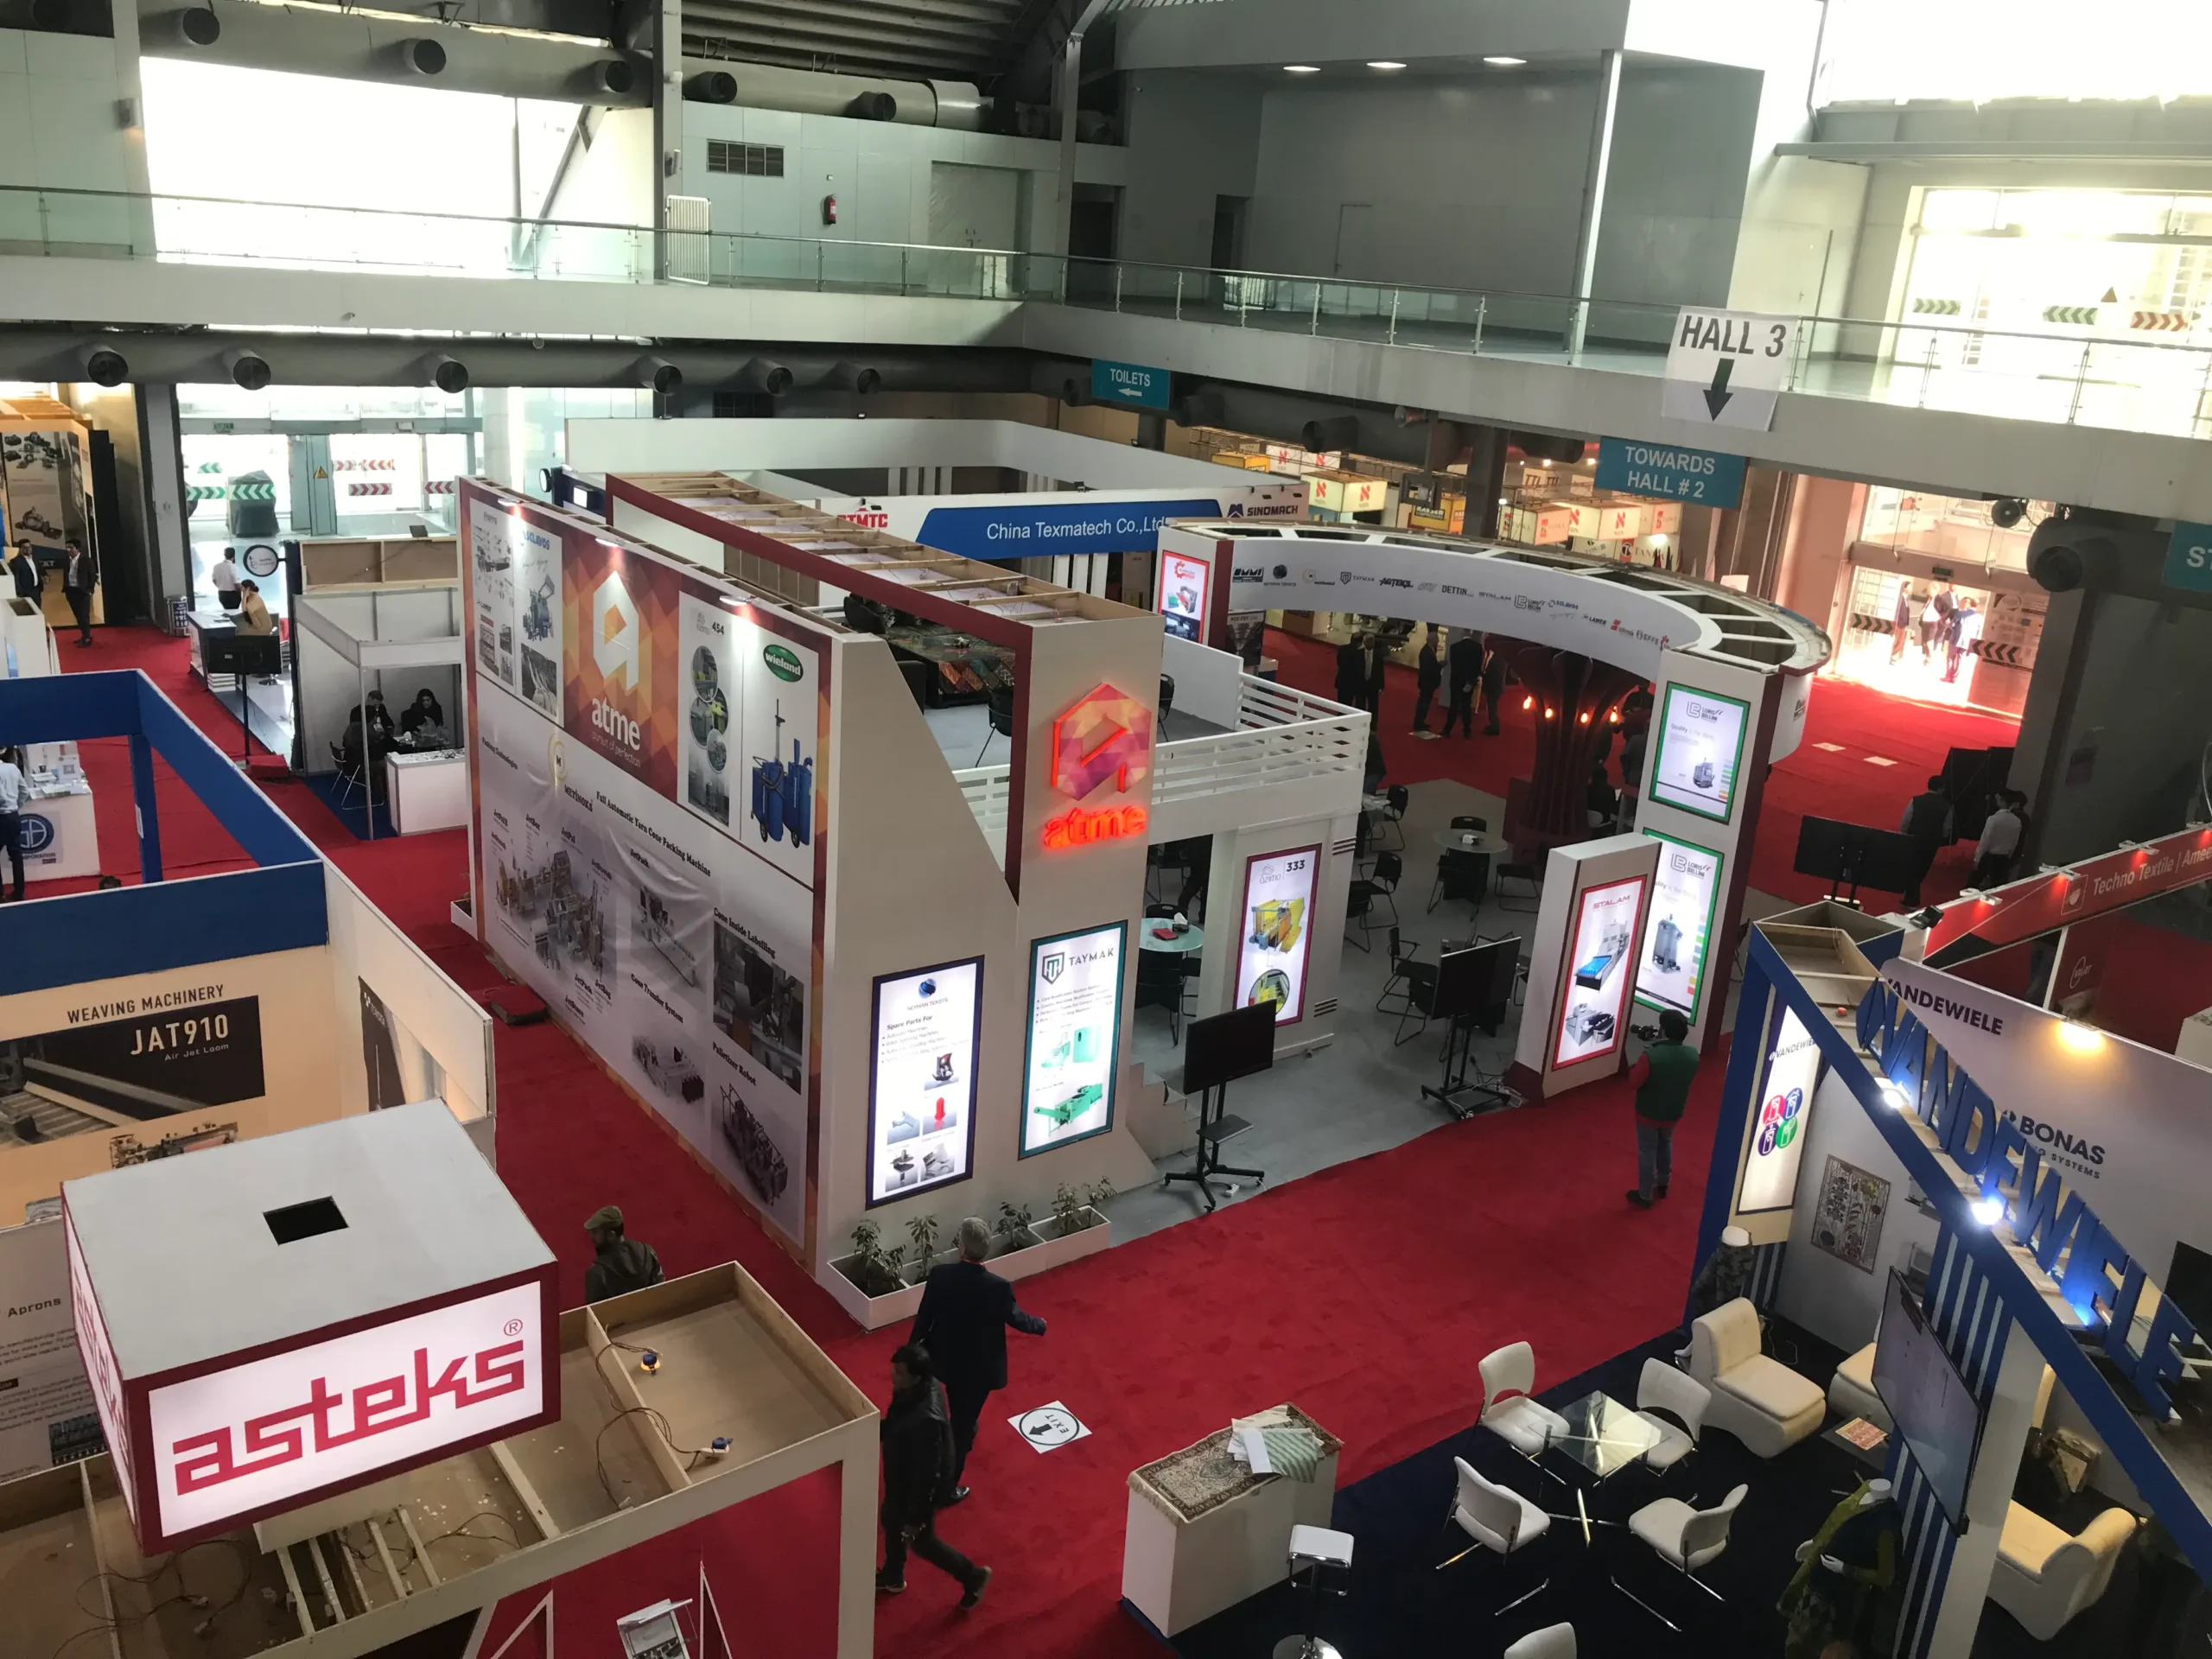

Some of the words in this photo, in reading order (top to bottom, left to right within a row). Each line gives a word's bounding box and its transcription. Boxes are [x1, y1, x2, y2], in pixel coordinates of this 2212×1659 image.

[1680, 315, 1754, 354] HALL
[1764, 324, 1787, 358] 3
[1110, 368, 1151, 387] TOILETS
[1625, 446, 1715, 474] TOWARDS
[1627, 470, 1673, 493] HALL
[837, 513, 887, 528] TMTC
[1247, 505, 1298, 517] SINOMACH
[987, 523, 1031, 540] China
[1035, 518, 1111, 538] Texmatech
[712, 621, 724, 635] 454
[765, 652, 801, 676] wieland
[592, 697, 640, 751] atme
[615, 746, 641, 768] perfection
[596, 791, 607, 804] Full
[607, 799, 634, 823] Automatic
[634, 817, 648, 834] Yarn
[648, 827, 662, 843] Cone
[663, 836, 685, 861] Packing
[687, 852, 711, 877] Machine
[1043, 805, 1148, 850] atme
[1286, 860, 1305, 872] 333
[1687, 867, 1705, 878] BELLINI
[1688, 861, 1702, 871] LORIS
[2093, 871, 2135, 896] Techno
[2139, 855, 2174, 881] Textile
[714, 907, 728, 924] Cone
[728, 917, 747, 938] Inside
[747, 931, 776, 959] Labelling
[1069, 947, 1114, 966] TAYMAK
[67, 1000, 136, 1024] WEAVING
[141, 984, 225, 1011] MACHINERY
[664, 1002, 683, 1024] System
[130, 1014, 229, 1055] JAT910
[887, 1021, 905, 1031] Spare
[906, 1017, 922, 1026] Parts
[165, 1052, 180, 1062] Air
[183, 1048, 200, 1058] Jet
[203, 1043, 229, 1053] Loom
[712, 1040, 738, 1071] Palletizer
[739, 1062, 756, 1086] Robot
[2019, 1115, 2106, 1165] BONAS
[2051, 1153, 2101, 1179] SYSTEMS
[8, 1298, 61, 1318] Aprons
[172, 1339, 525, 1496] asteks
[1045, 1414, 1070, 1434] EXIT
